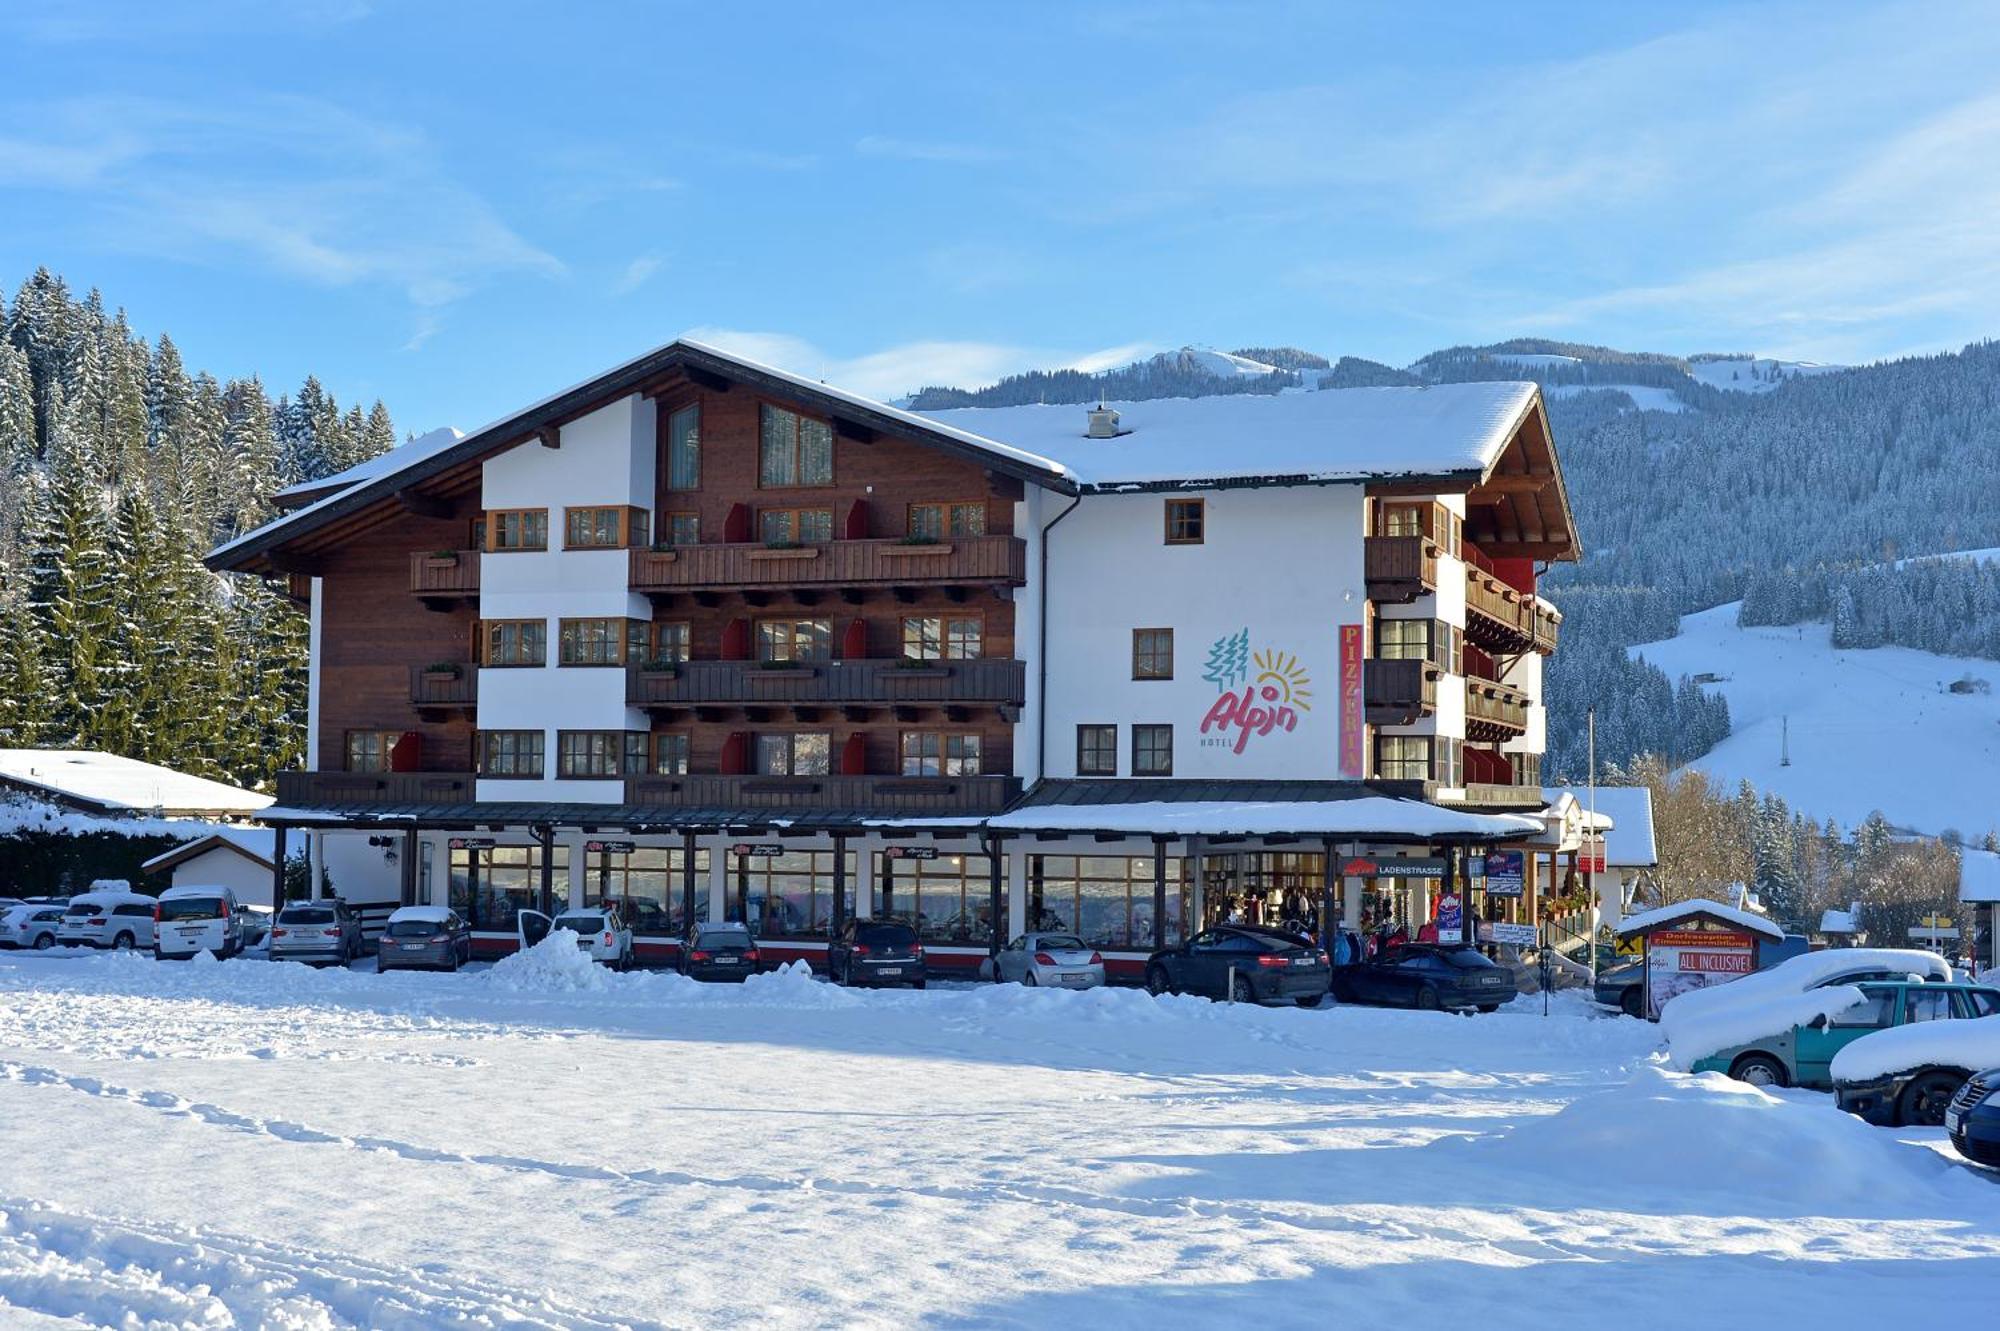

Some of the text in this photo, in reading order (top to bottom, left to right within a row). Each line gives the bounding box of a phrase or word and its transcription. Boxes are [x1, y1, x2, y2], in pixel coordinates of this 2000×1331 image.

[1345, 627, 1359, 770] PIZZERIA
[1199, 685, 1298, 755] Alpin
[1200, 738, 1233, 748] HOTEL
[1379, 866, 1443, 875] LADENSTRASSE
[1679, 954, 1751, 972] ALL INCLUSIVE!
